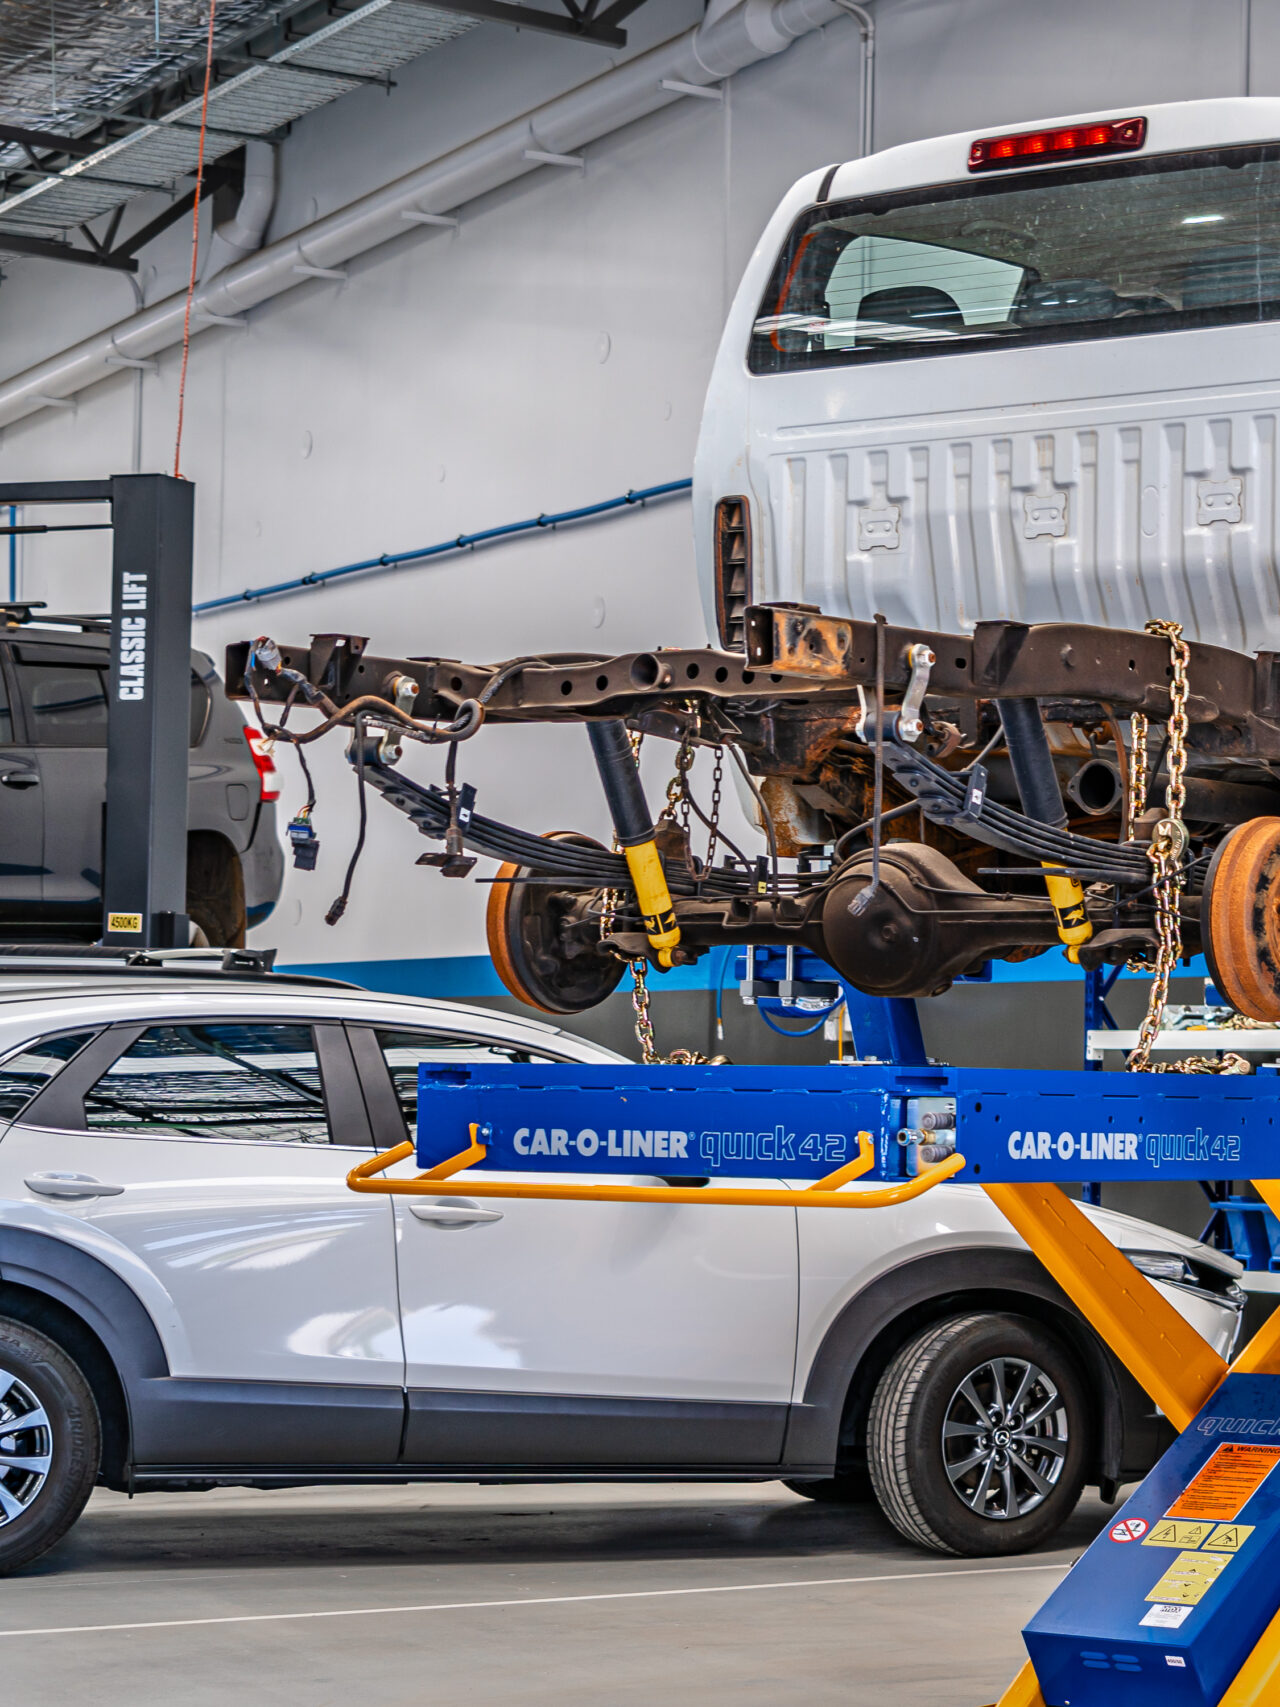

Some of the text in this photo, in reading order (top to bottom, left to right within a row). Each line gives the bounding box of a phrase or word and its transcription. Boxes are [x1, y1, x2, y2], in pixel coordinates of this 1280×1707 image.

[119, 571, 148, 701] CLASSIC LIFT
[111, 916, 138, 929] 4500KG
